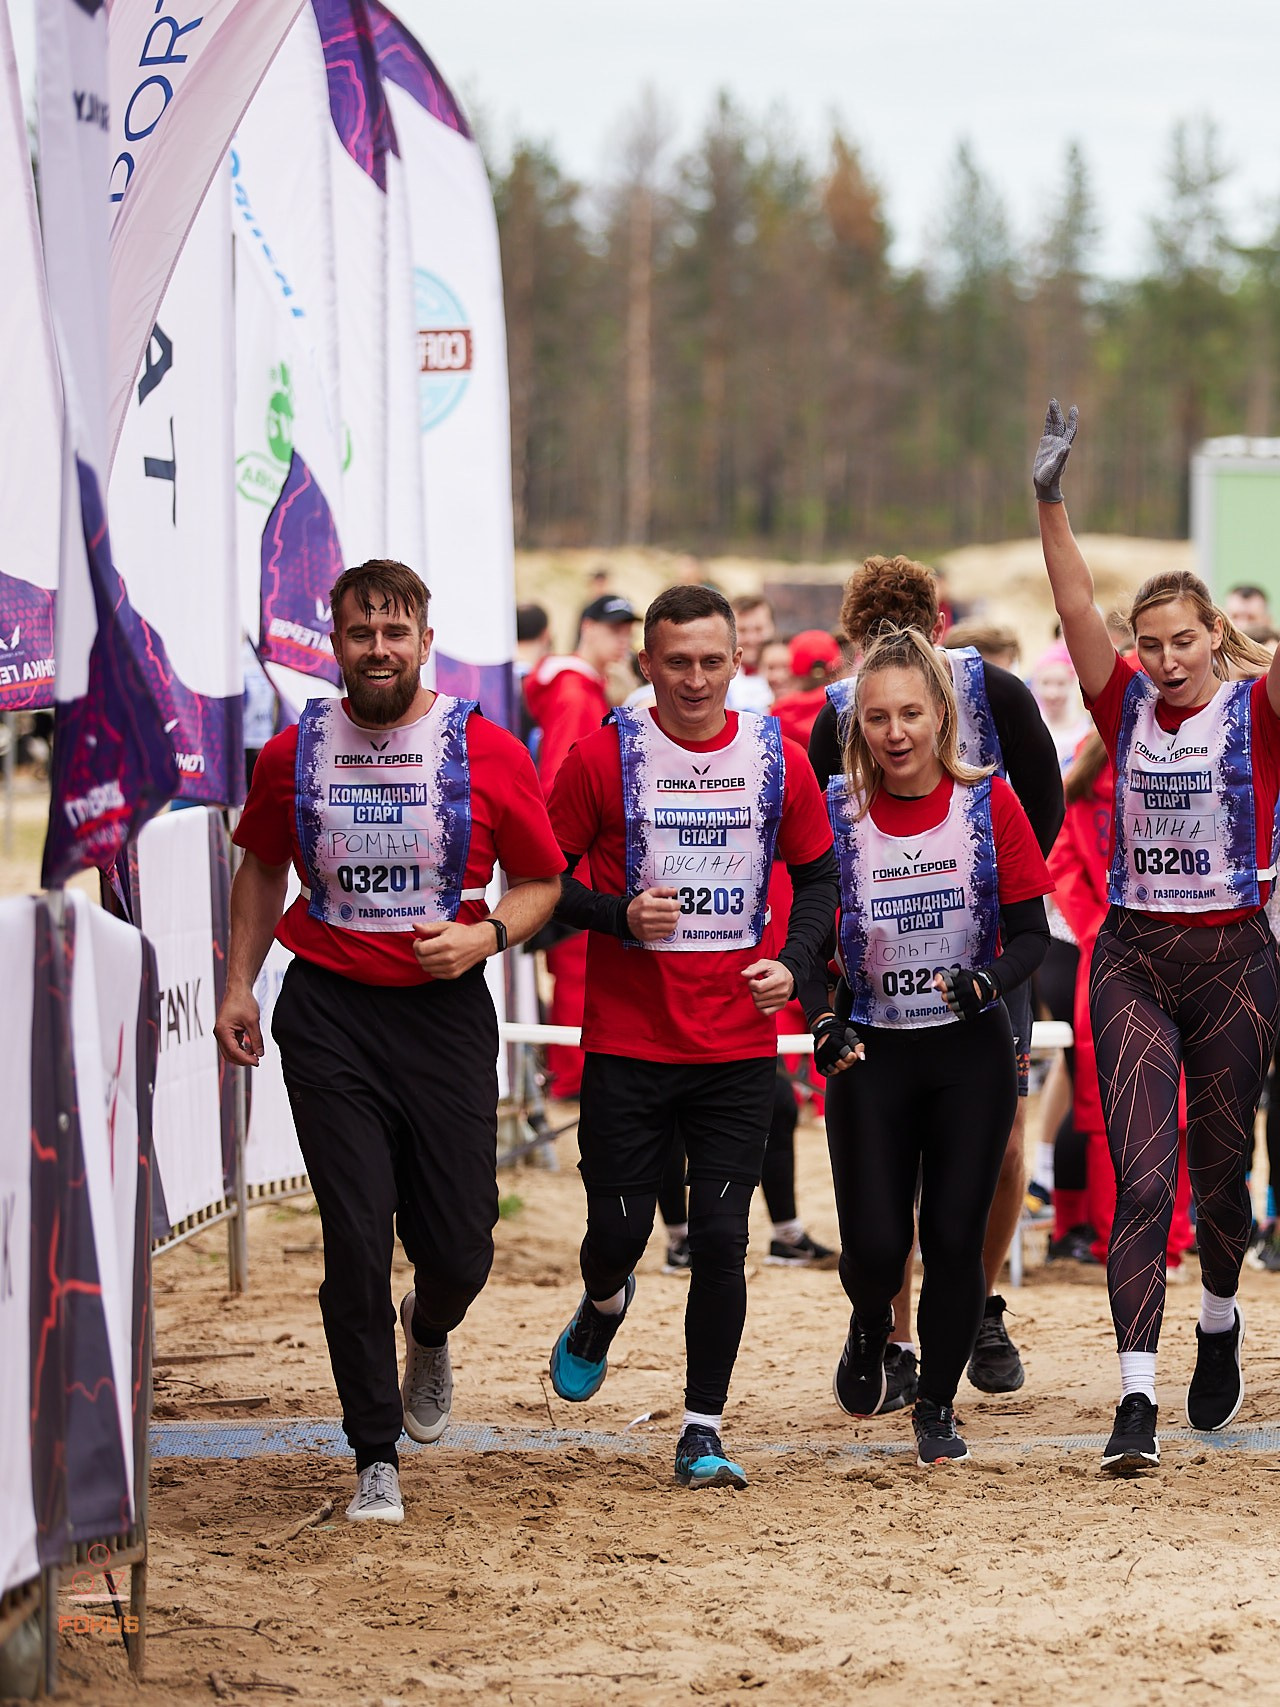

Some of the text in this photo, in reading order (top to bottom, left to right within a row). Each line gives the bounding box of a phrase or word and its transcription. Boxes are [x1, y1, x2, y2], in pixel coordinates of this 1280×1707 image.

[110, 0, 203, 203] POR
[335, 754, 423, 765] ГОНКА ГЕРОЕВ
[1135, 741, 1208, 763] ГОНКА ГЕРОЕВ
[331, 783, 425, 806] КОМАНДНЫЙ
[657, 778, 745, 789] ГОНКА ГЕРОЕВ
[1146, 793, 1187, 808] СТАРТ
[356, 806, 400, 822] СТАРТ
[656, 806, 749, 828] КОМАНДНЫЙ
[681, 829, 724, 845] СТАРТ
[1132, 816, 1205, 840] АЛИНА
[331, 832, 419, 859] РОМАН
[873, 859, 957, 879] ГОНКА ГЕРОЕВ
[1133, 848, 1211, 875] 03208
[337, 865, 420, 893] 03201
[669, 886, 745, 915] 3203
[873, 887, 964, 918] КОМАНДНЫЙ
[1153, 888, 1216, 899] ГАЗПРОМБАНК
[359, 905, 426, 918] ГАЗПРОМБАНК
[900, 912, 940, 932] СТАРТ
[682, 929, 744, 940] ГАЗПРОМБАНК
[882, 963, 961, 997] 032
